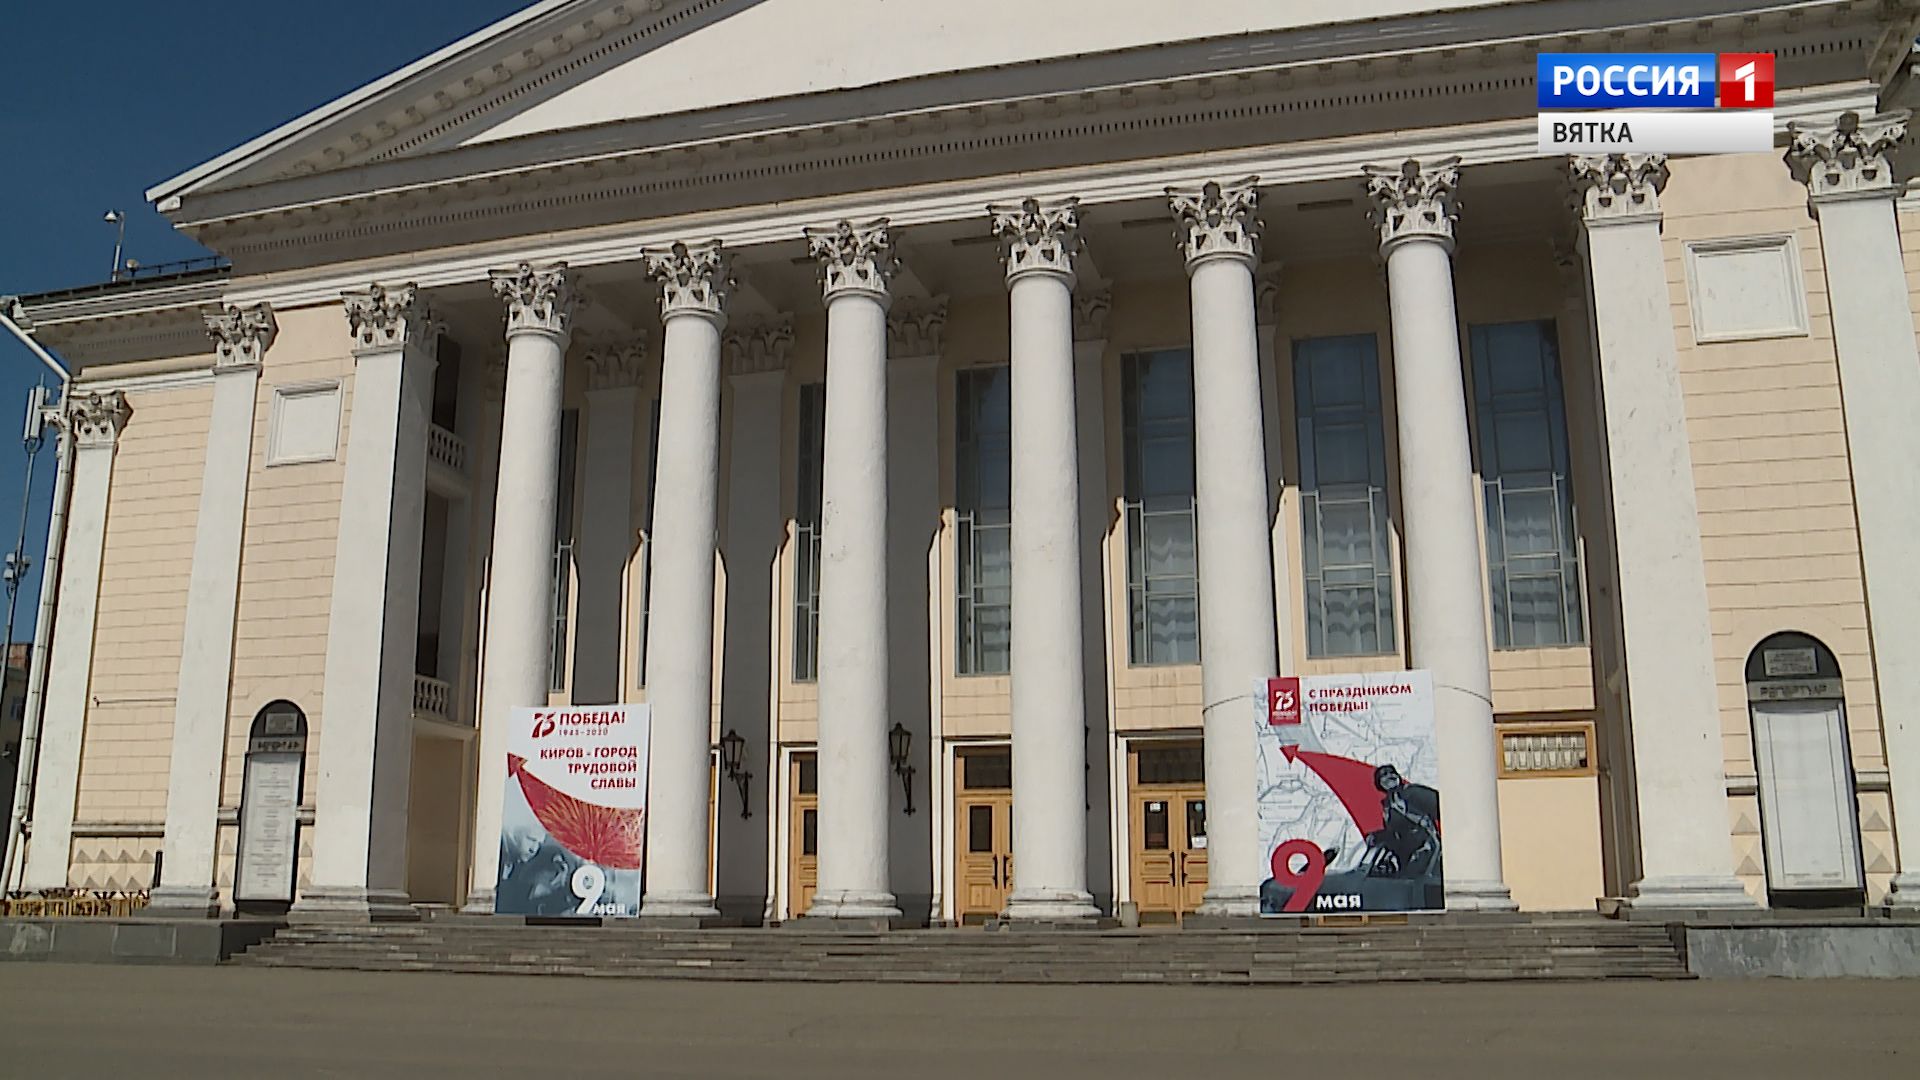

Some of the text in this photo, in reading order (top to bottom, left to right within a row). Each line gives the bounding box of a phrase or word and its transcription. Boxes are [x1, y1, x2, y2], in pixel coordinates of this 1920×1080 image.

[1275, 688, 1294, 709] 75
[1309, 683, 1412, 699] С ПРАЗДНИКОМ
[1309, 700, 1369, 713] ПОБЕДЫ!
[532, 711, 625, 738] 75 ПОБЕДА!
[540, 748, 583, 759] КИРОВ
[594, 746, 637, 758] ГОРОД
[568, 760, 637, 774] ТРУДОВОЙ
[590, 777, 636, 789] СЛАВЫ
[1271, 838, 1362, 912] 9 мая
[571, 864, 626, 914] 9 мая
